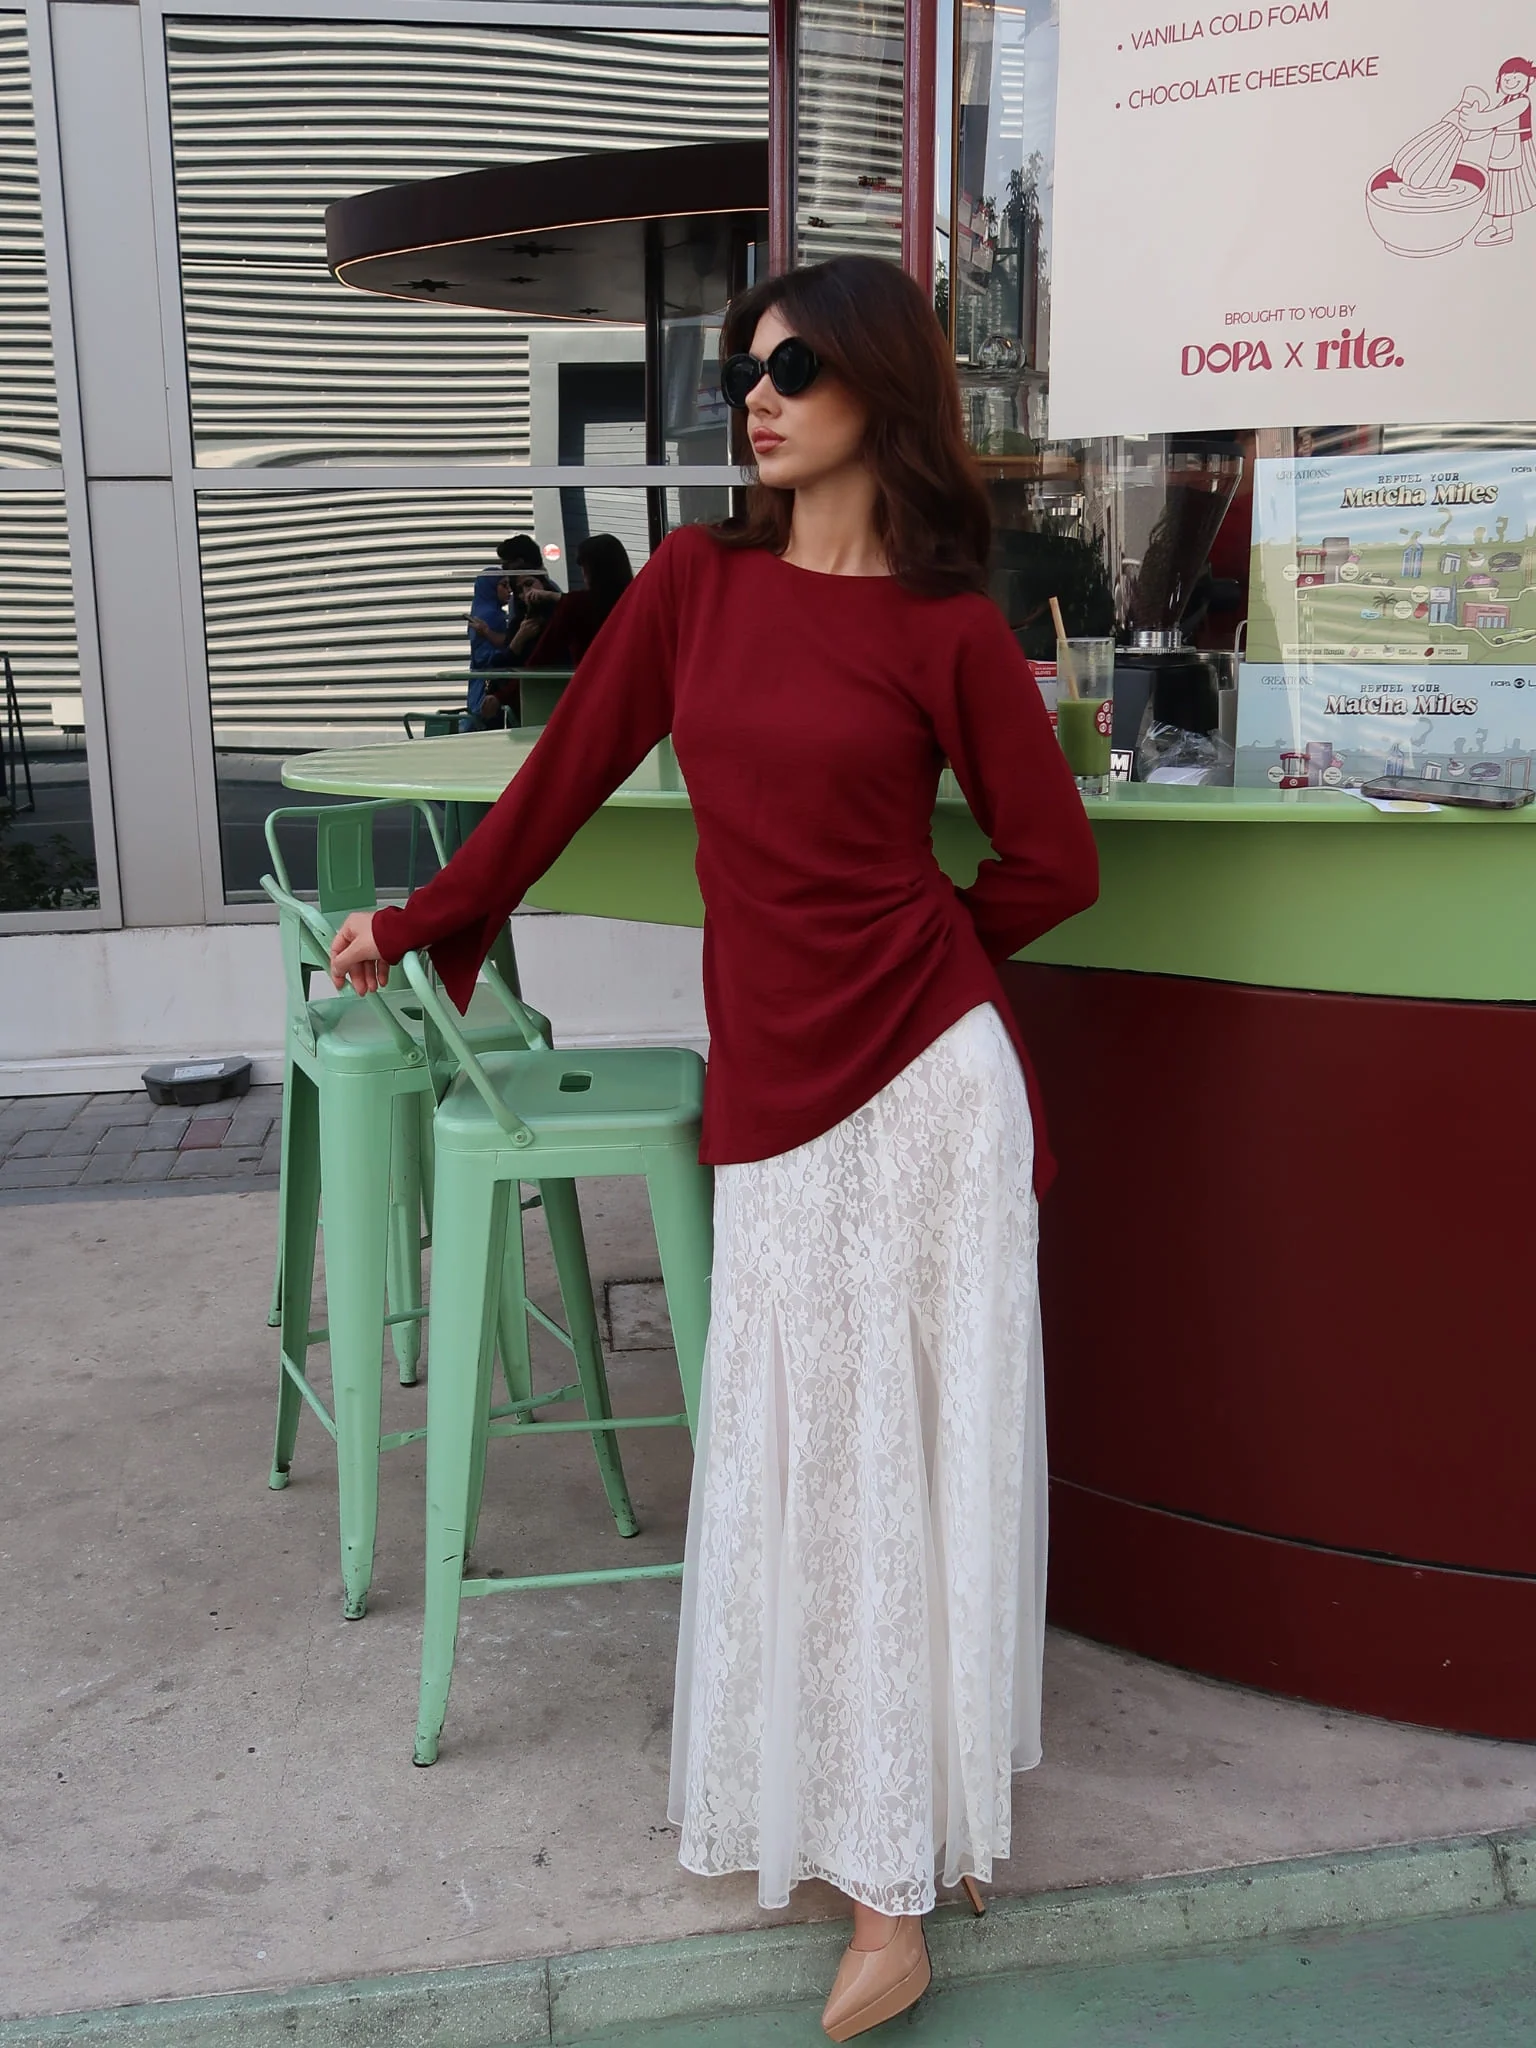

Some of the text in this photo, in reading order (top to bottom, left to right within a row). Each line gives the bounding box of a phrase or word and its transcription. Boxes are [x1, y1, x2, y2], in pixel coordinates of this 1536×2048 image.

[1131, 0, 1329, 51] VANILLA COLD FOAM
[1129, 56, 1380, 110] CHOCOLATE CHEESECAKE
[1225, 304, 1356, 325] BROUGHT TO YOU BY
[1181, 328, 1405, 376] DOPA X rite.
[1378, 473, 1460, 484] REFUEL YOUR
[1340, 482, 1498, 508] Matcha Miles
[1360, 683, 1440, 693] REFUEL YOUR
[1324, 692, 1478, 715] Matcha Miles
